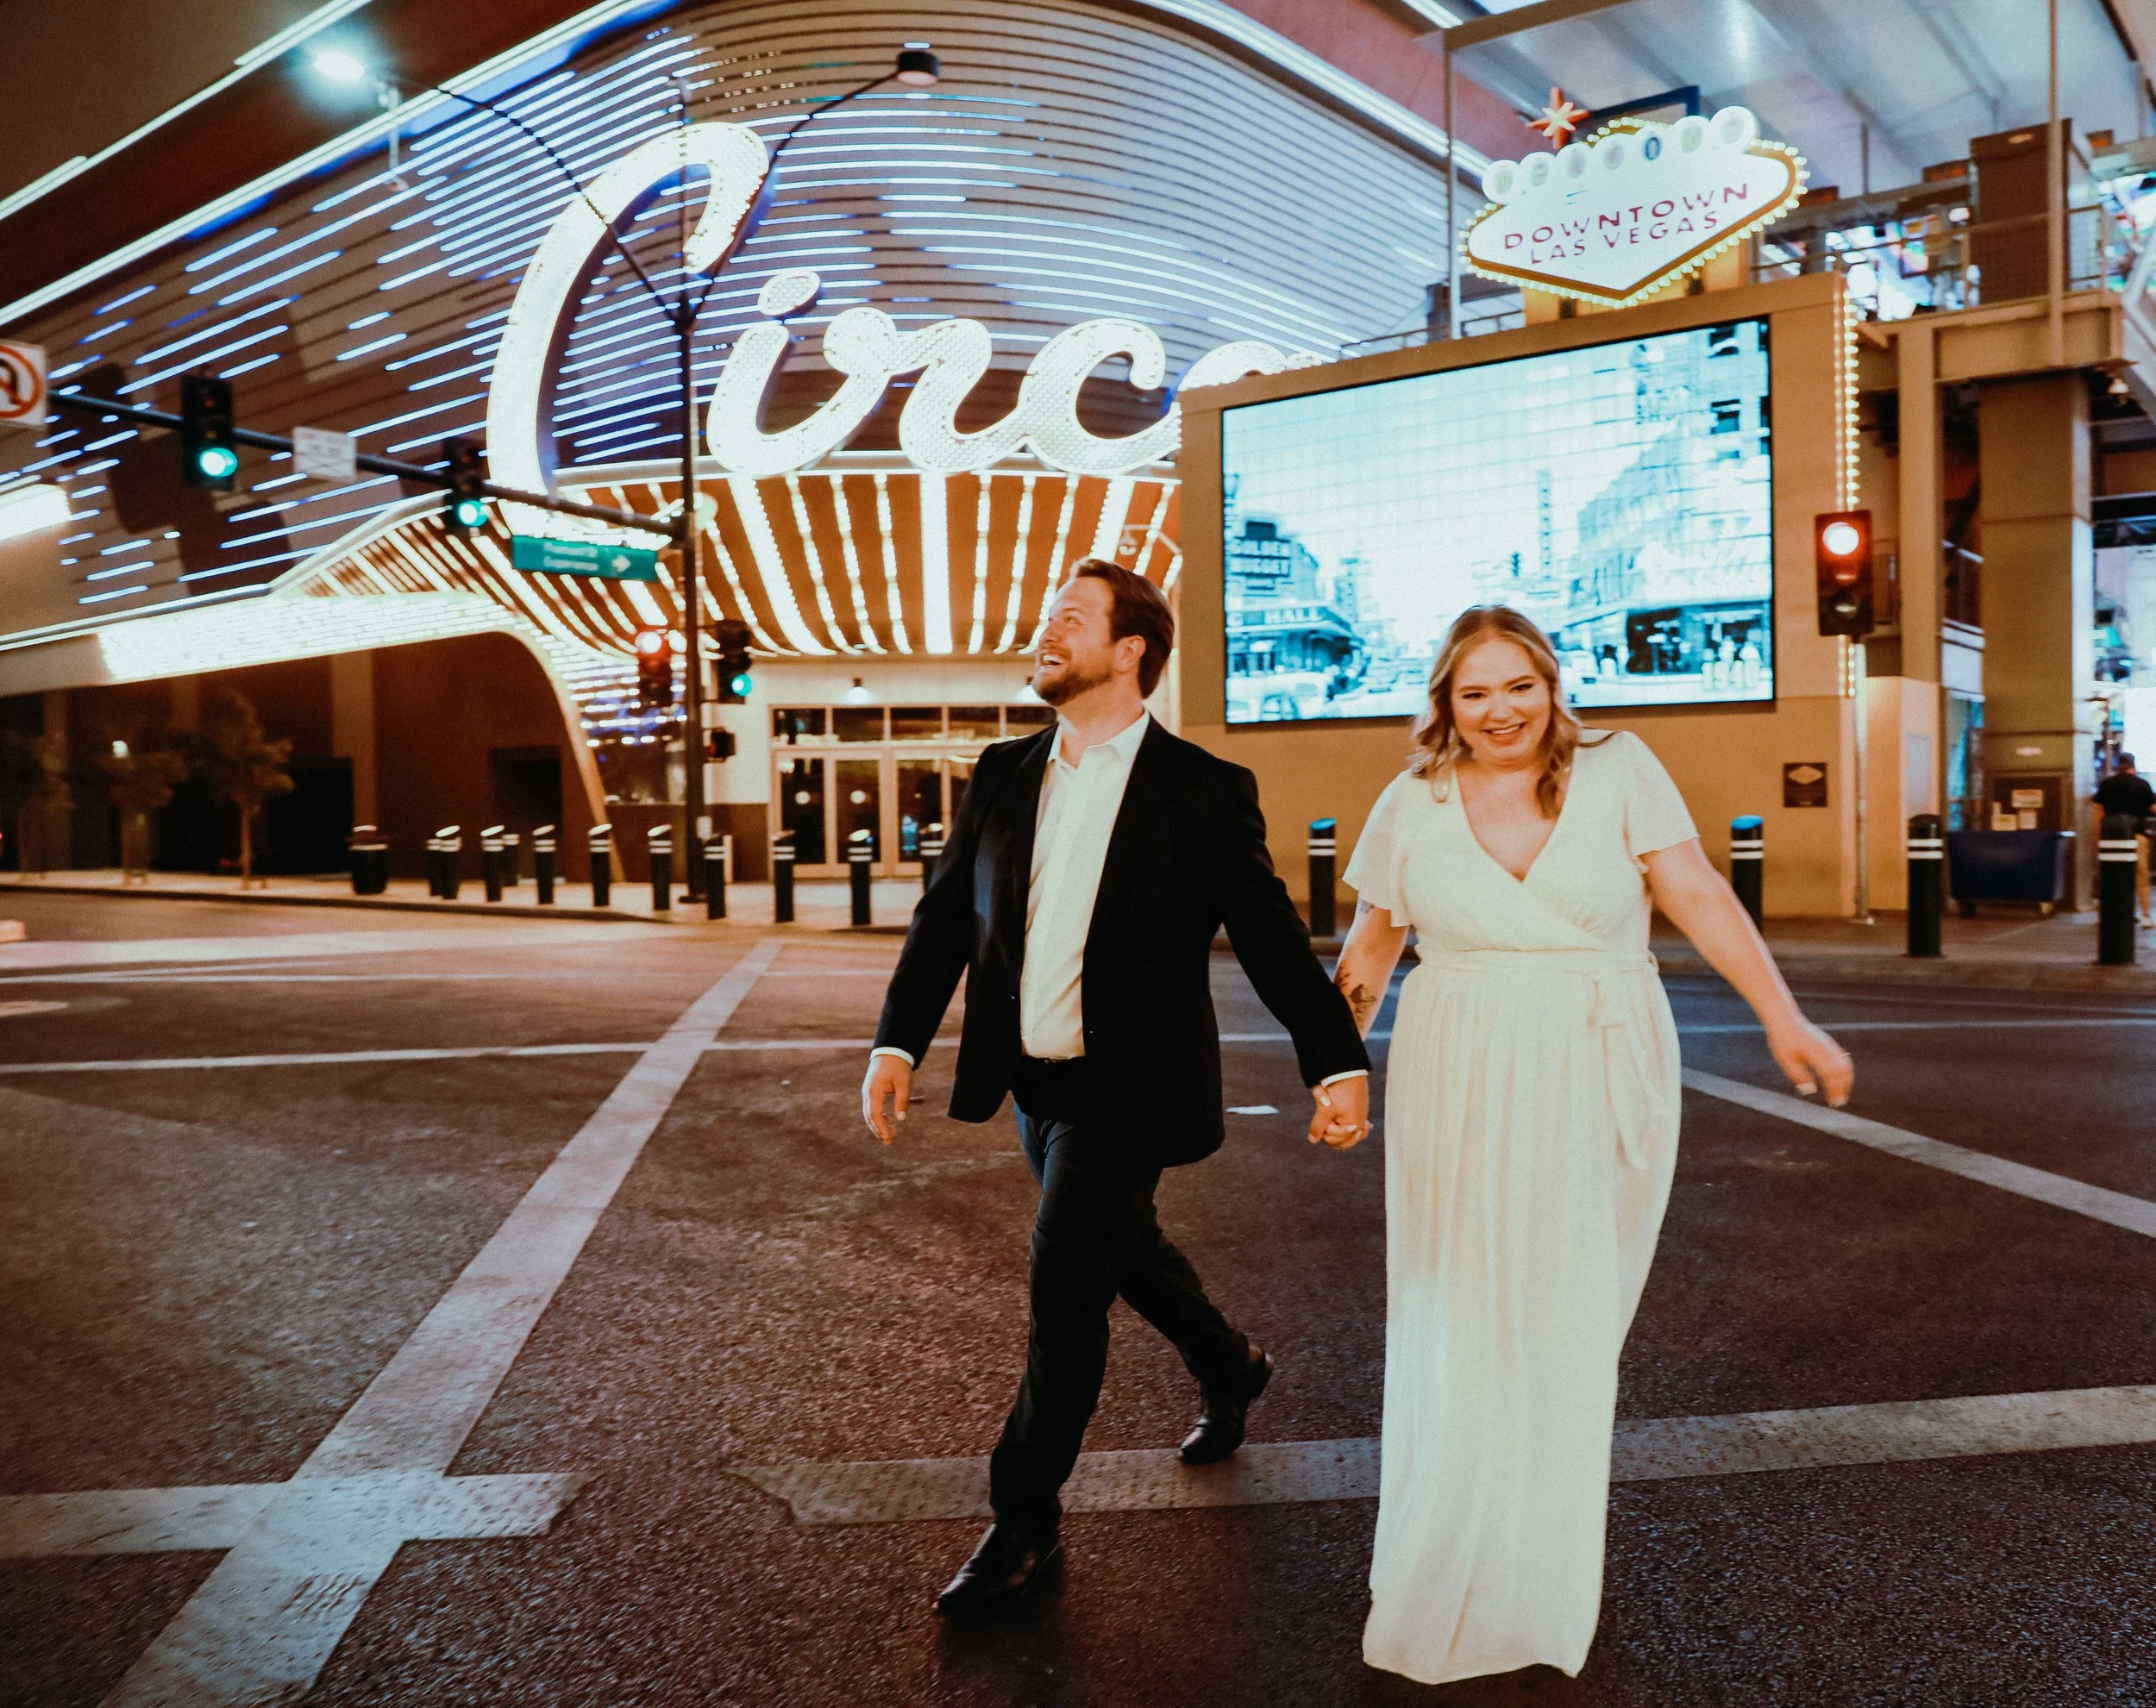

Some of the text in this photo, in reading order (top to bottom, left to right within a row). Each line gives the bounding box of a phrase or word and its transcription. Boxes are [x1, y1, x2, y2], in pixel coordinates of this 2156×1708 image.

[1505, 183, 1747, 250] DOWNTOWN
[1531, 210, 1718, 264] LAS VEGAS
